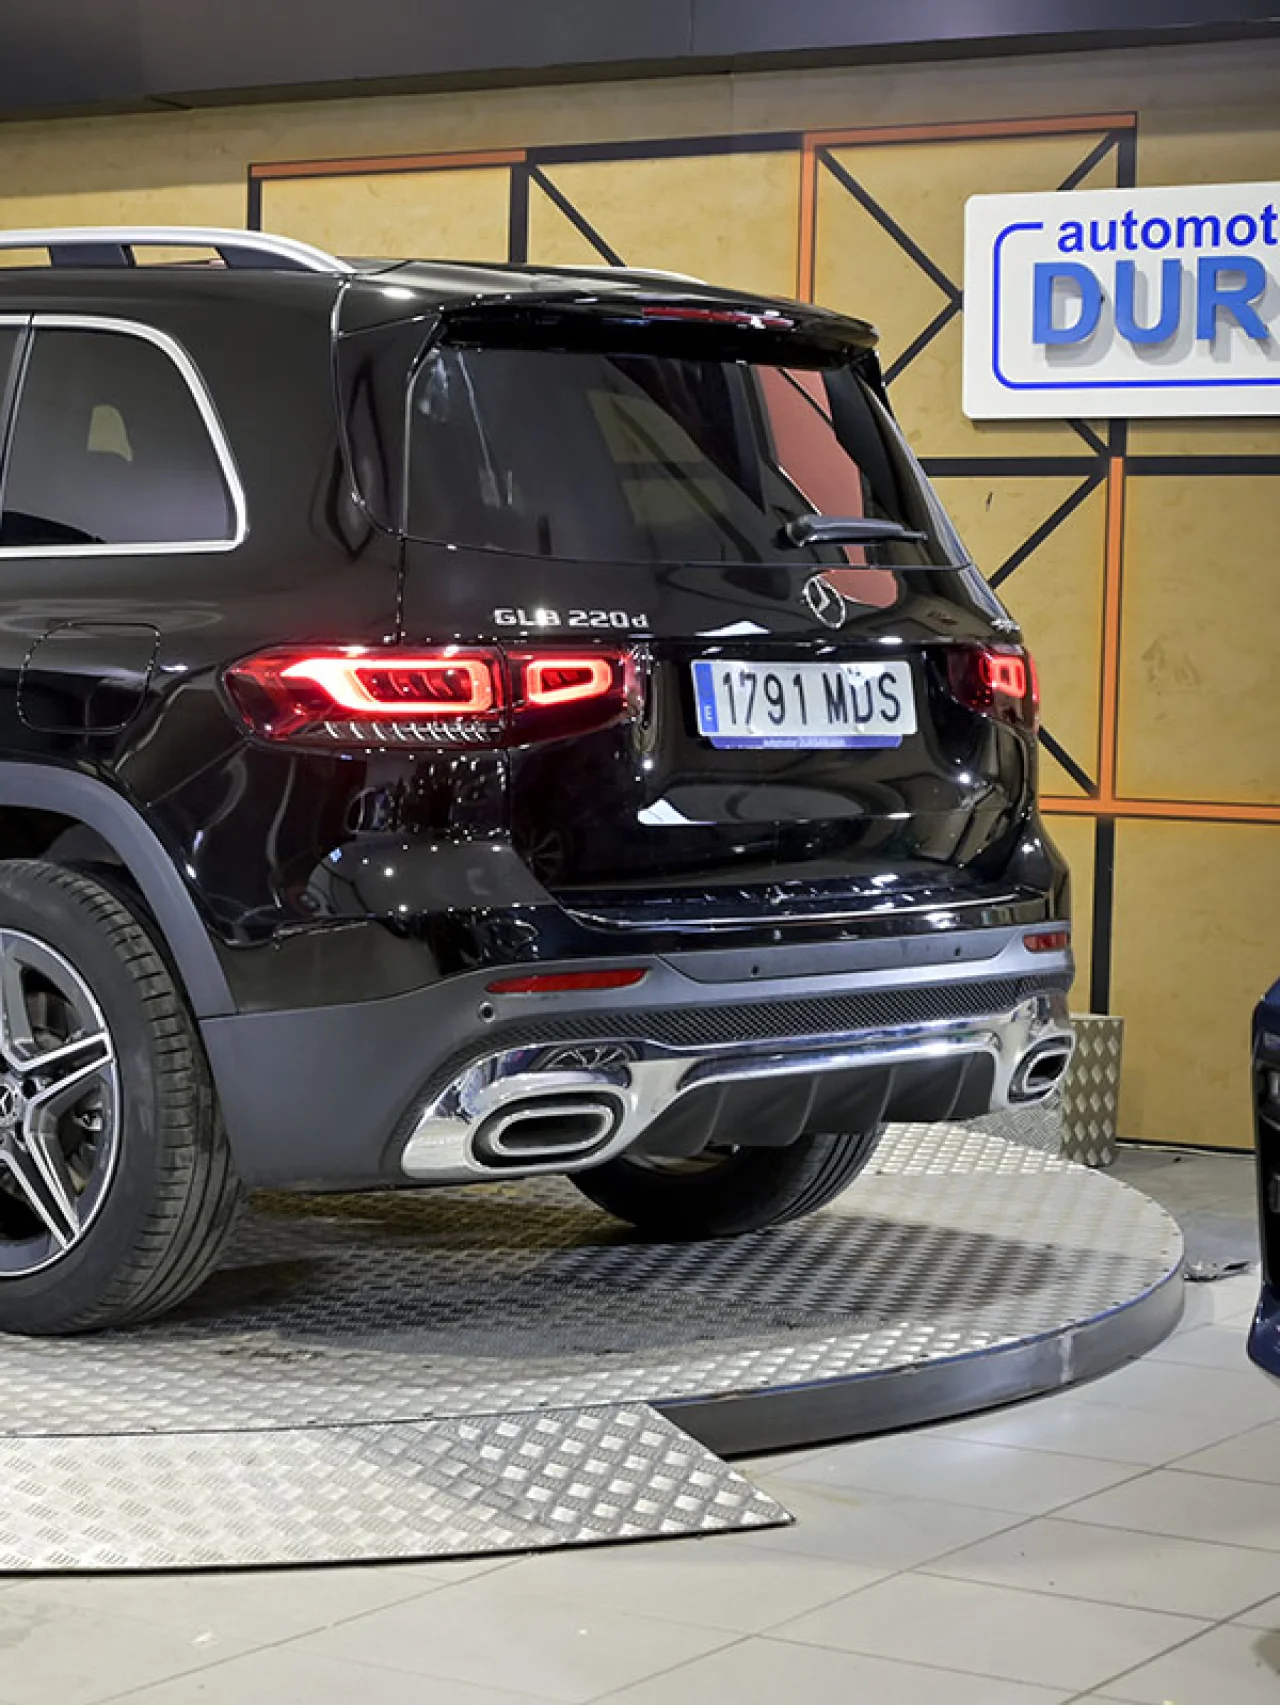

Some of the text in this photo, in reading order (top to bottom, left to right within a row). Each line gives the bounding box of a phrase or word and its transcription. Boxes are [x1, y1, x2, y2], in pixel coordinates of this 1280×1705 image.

[1057, 204, 1279, 253] automot
[1032, 255, 1270, 345] DUR
[494, 608, 649, 628] GLB 220d
[704, 705, 713, 721] E
[723, 671, 901, 726] 1791 MDS
